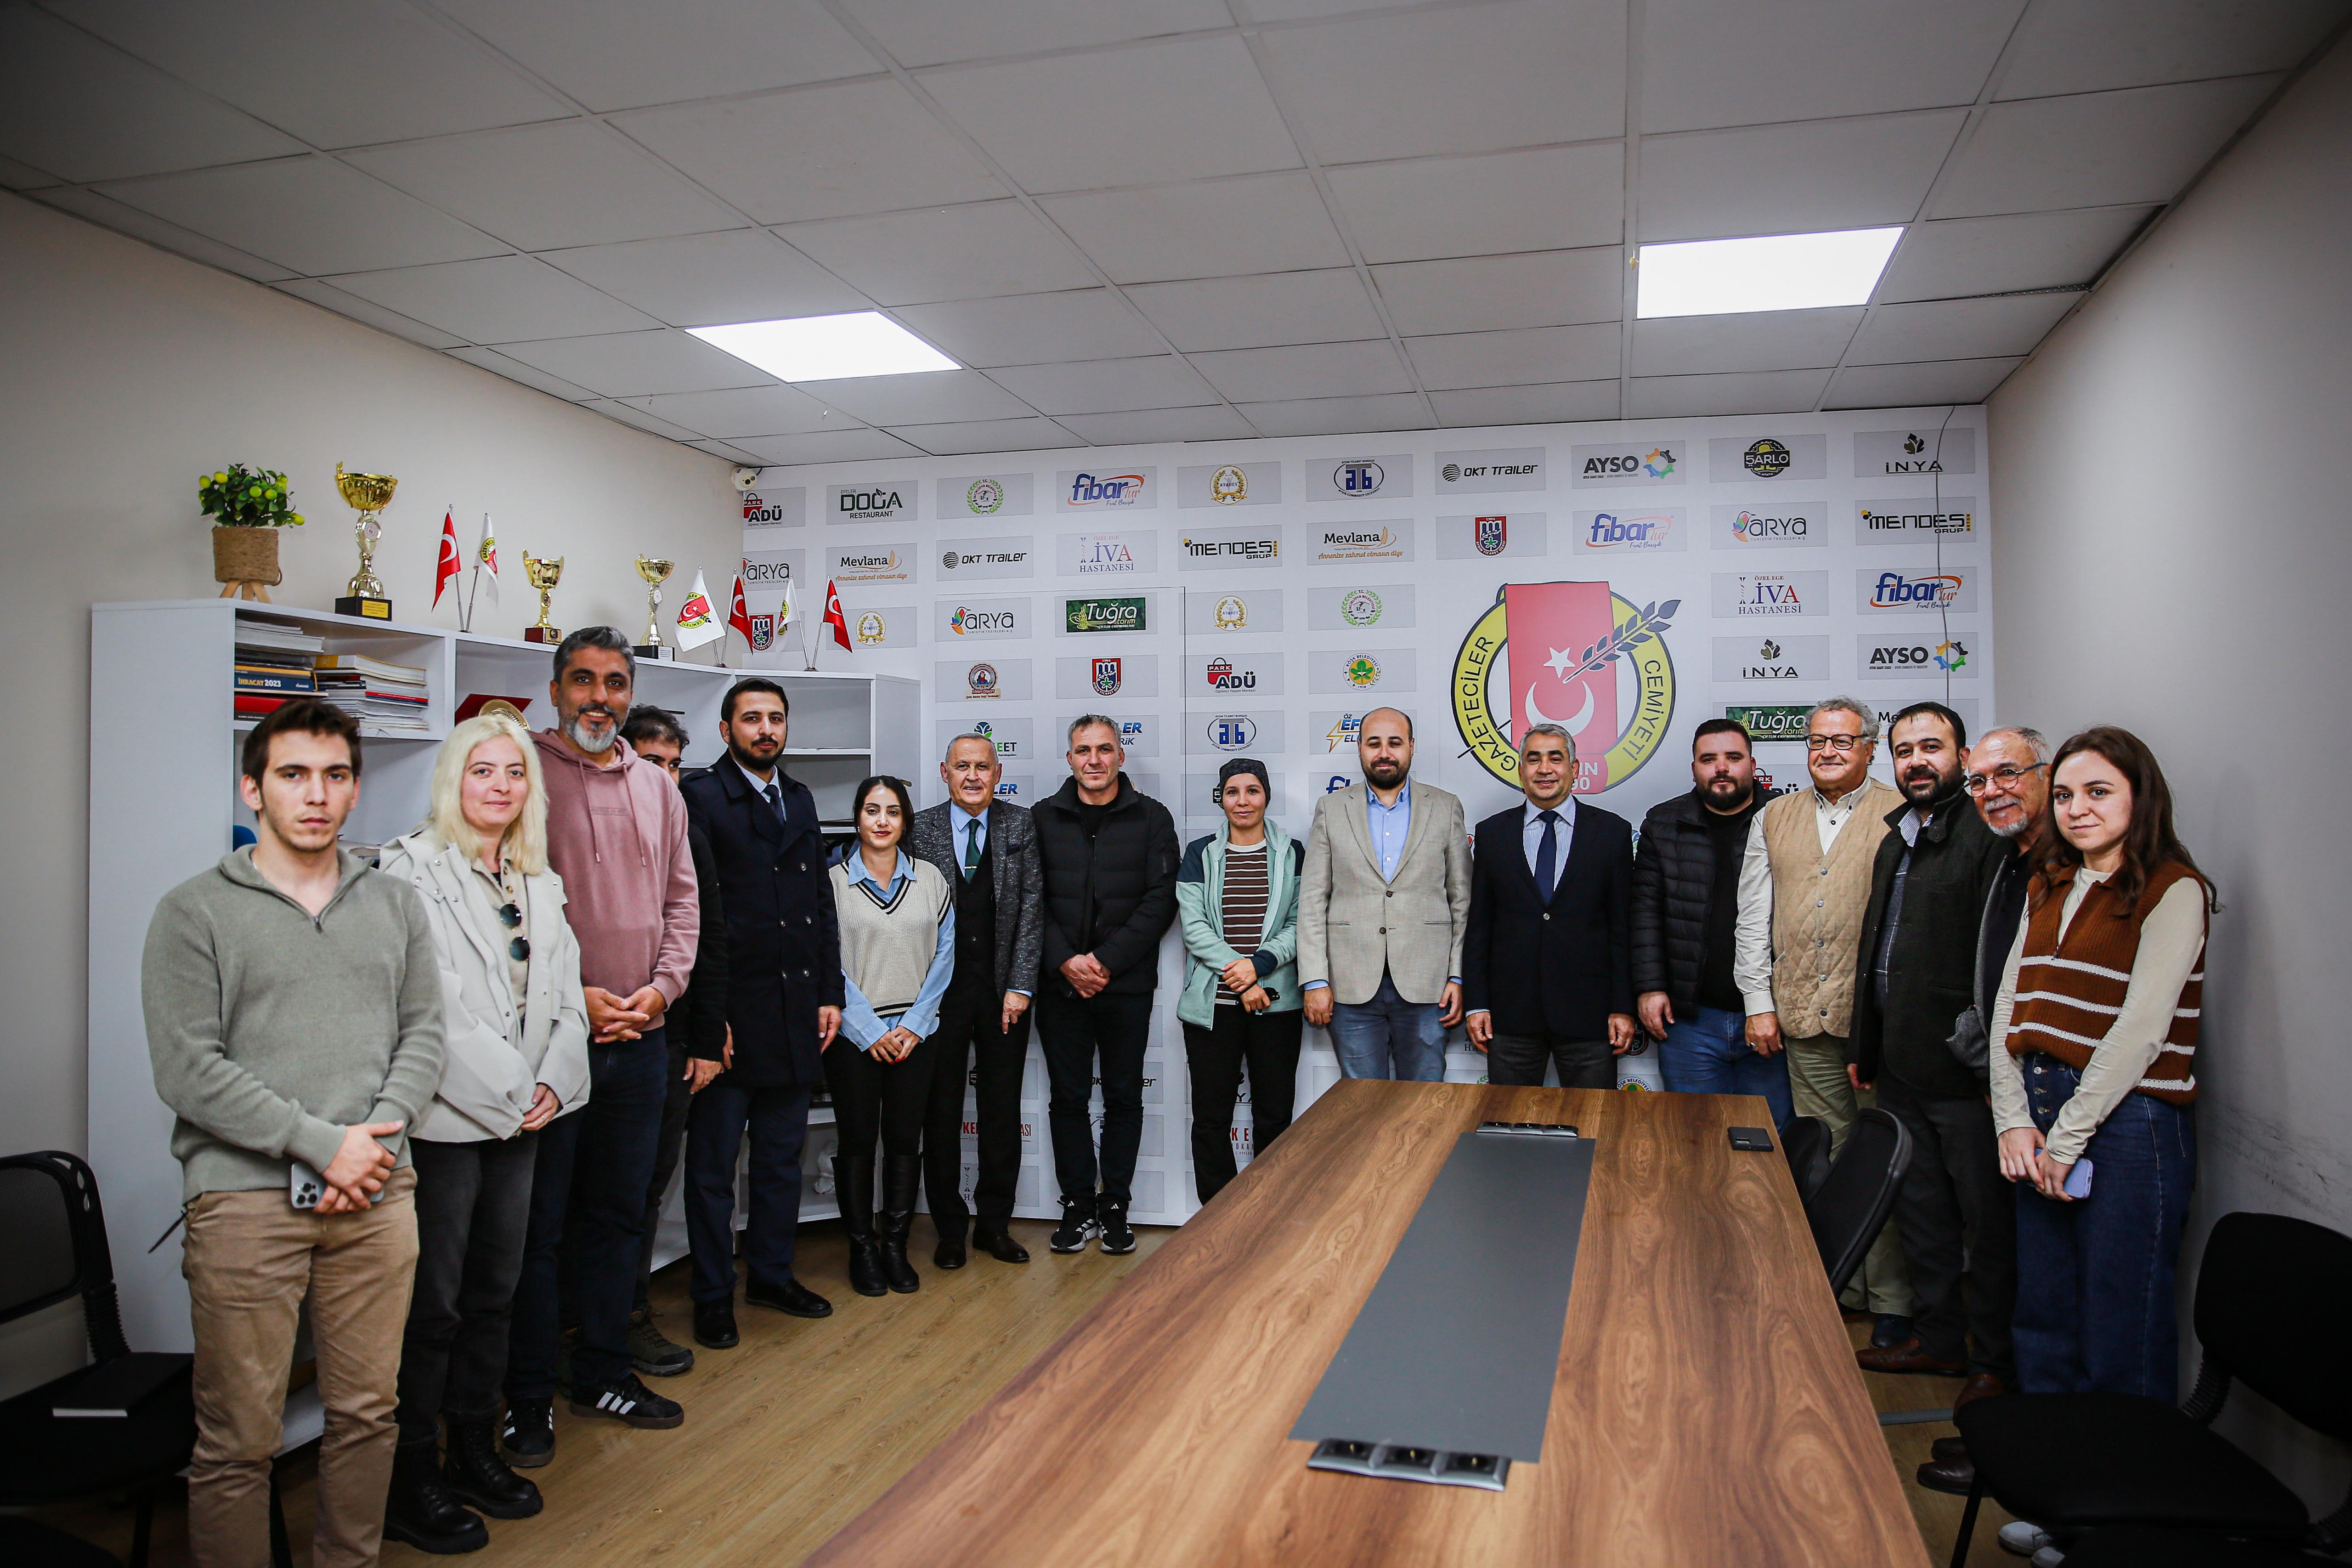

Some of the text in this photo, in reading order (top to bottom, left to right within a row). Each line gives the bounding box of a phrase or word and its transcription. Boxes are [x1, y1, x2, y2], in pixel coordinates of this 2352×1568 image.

[1464, 467, 1487, 476] OKT
[1583, 455, 1639, 473] AYSO
[1073, 473, 1129, 500] fibar
[748, 505, 782, 522] ADÜ
[850, 511, 893, 519] RESTAURANT
[1591, 513, 1655, 542] fibar
[1324, 532, 1381, 544] Mevlana
[840, 555, 889, 567] Mevlana
[962, 555, 982, 564] OKT
[1080, 561, 1134, 572] HASTANESİ
[1876, 572, 1943, 601] fibar
[1087, 602, 1137, 624] Tuğra
[1738, 603, 1802, 614] HASTANESİ
[1357, 654, 1378, 667] BELEDİYESİ
[1870, 646, 1928, 664] AYSO
[1216, 671, 1256, 689] ADÜ
[1460, 636, 1664, 772] GAZETECİLER CEMİYETİ
[1627, 1078, 1650, 1091] BELEDİYES
